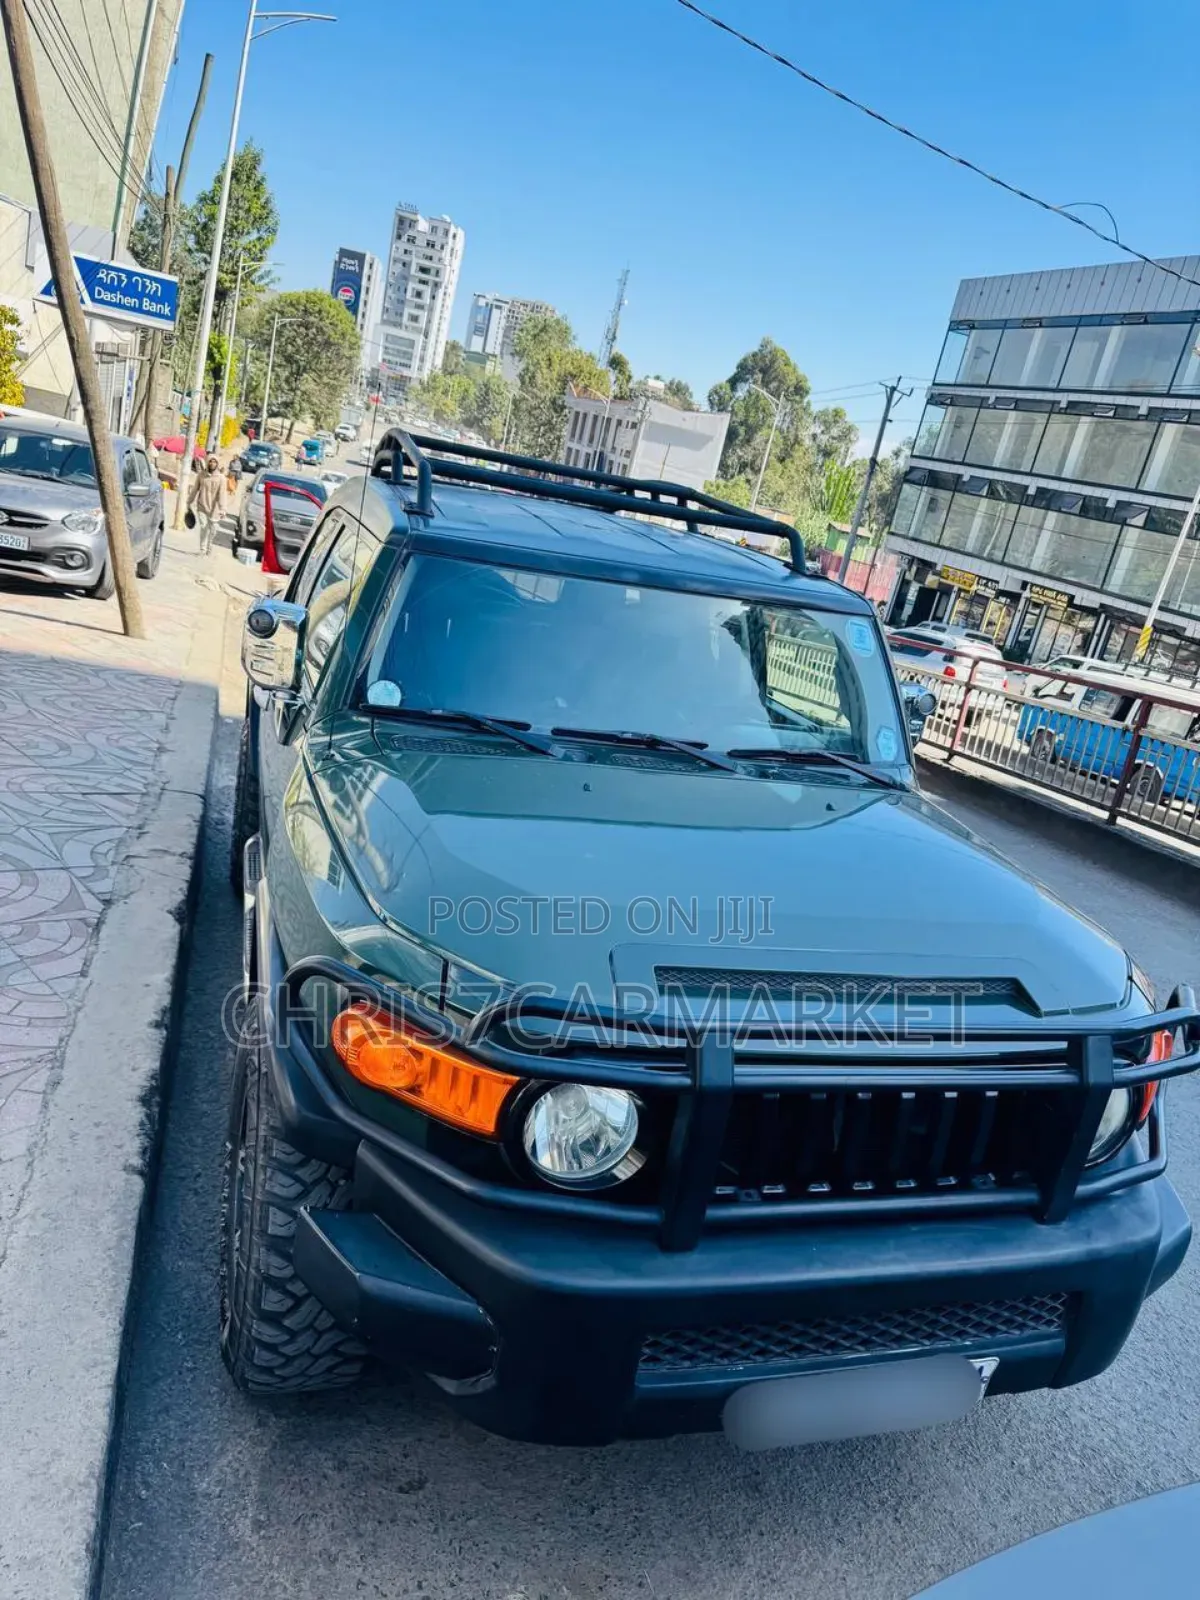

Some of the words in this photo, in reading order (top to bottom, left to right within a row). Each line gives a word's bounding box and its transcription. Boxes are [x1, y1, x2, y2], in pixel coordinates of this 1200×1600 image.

[132, 276, 162, 297] ባንክ
[94, 286, 139, 308] Dashen
[142, 297, 171, 316] Bank
